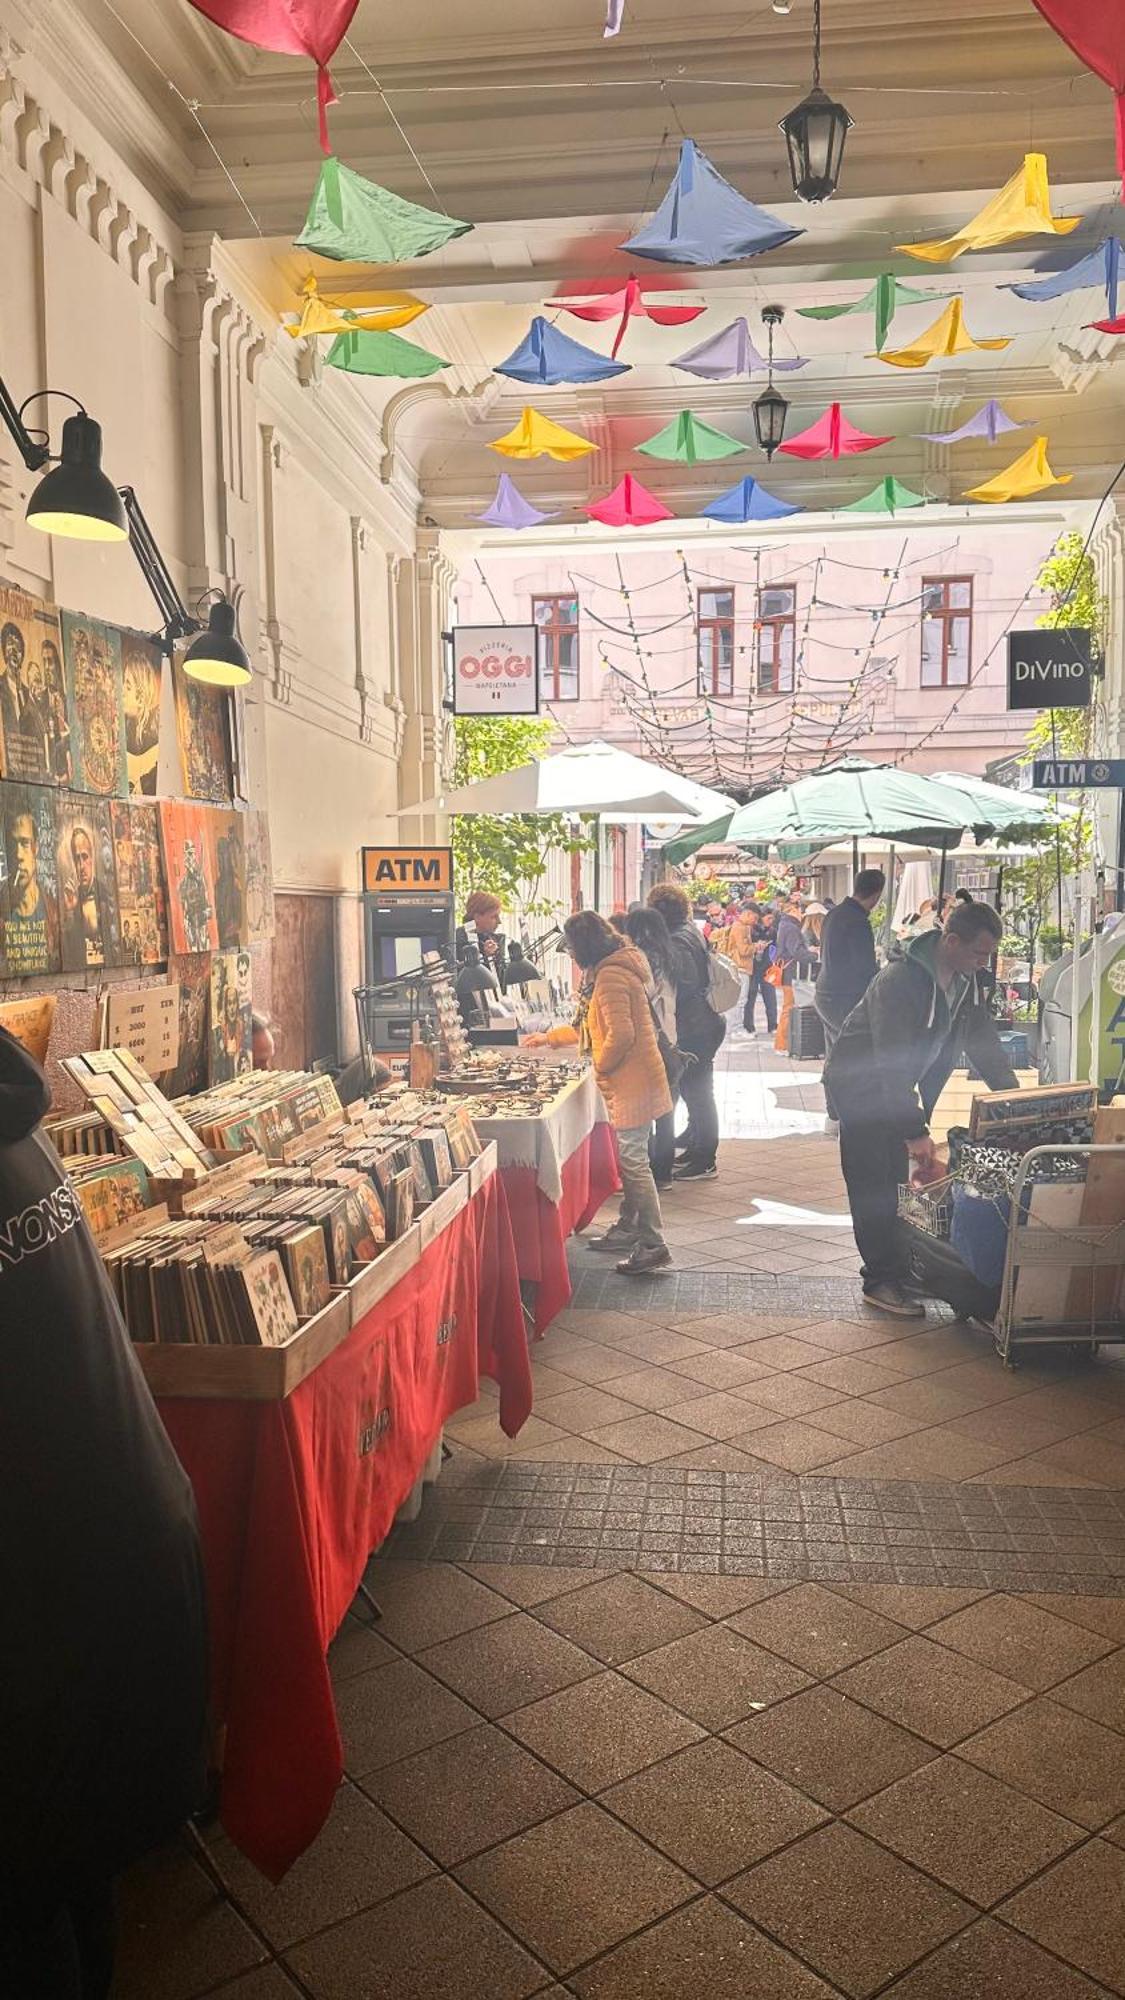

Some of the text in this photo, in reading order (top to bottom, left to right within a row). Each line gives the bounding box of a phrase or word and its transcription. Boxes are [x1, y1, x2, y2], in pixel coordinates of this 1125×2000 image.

[460, 656, 532, 679] OGGI
[1041, 763, 1086, 784] ATM
[375, 858, 441, 881] ATM
